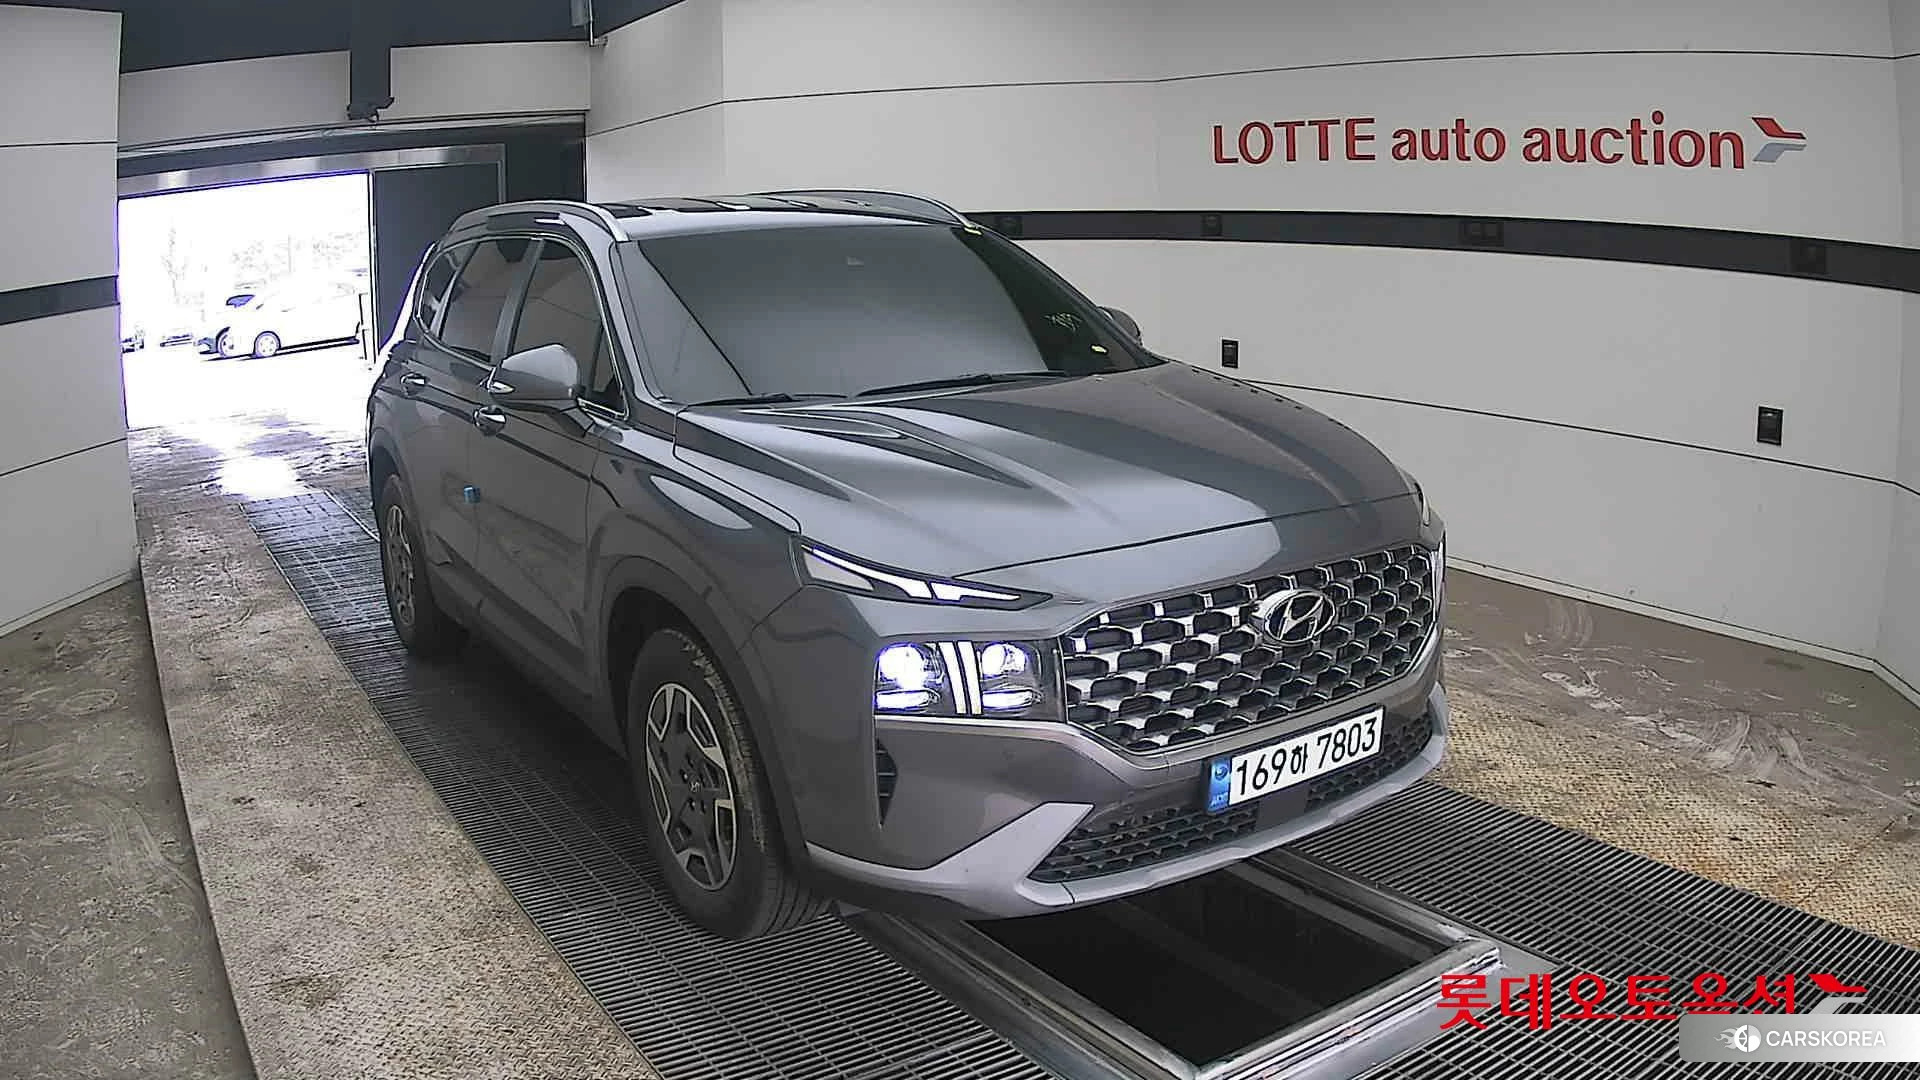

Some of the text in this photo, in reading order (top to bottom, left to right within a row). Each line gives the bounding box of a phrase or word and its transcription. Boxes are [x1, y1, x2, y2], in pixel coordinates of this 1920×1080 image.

[1213, 110, 1744, 169] LOTTE auto auction
[1236, 716, 1378, 796] 169하 7803
